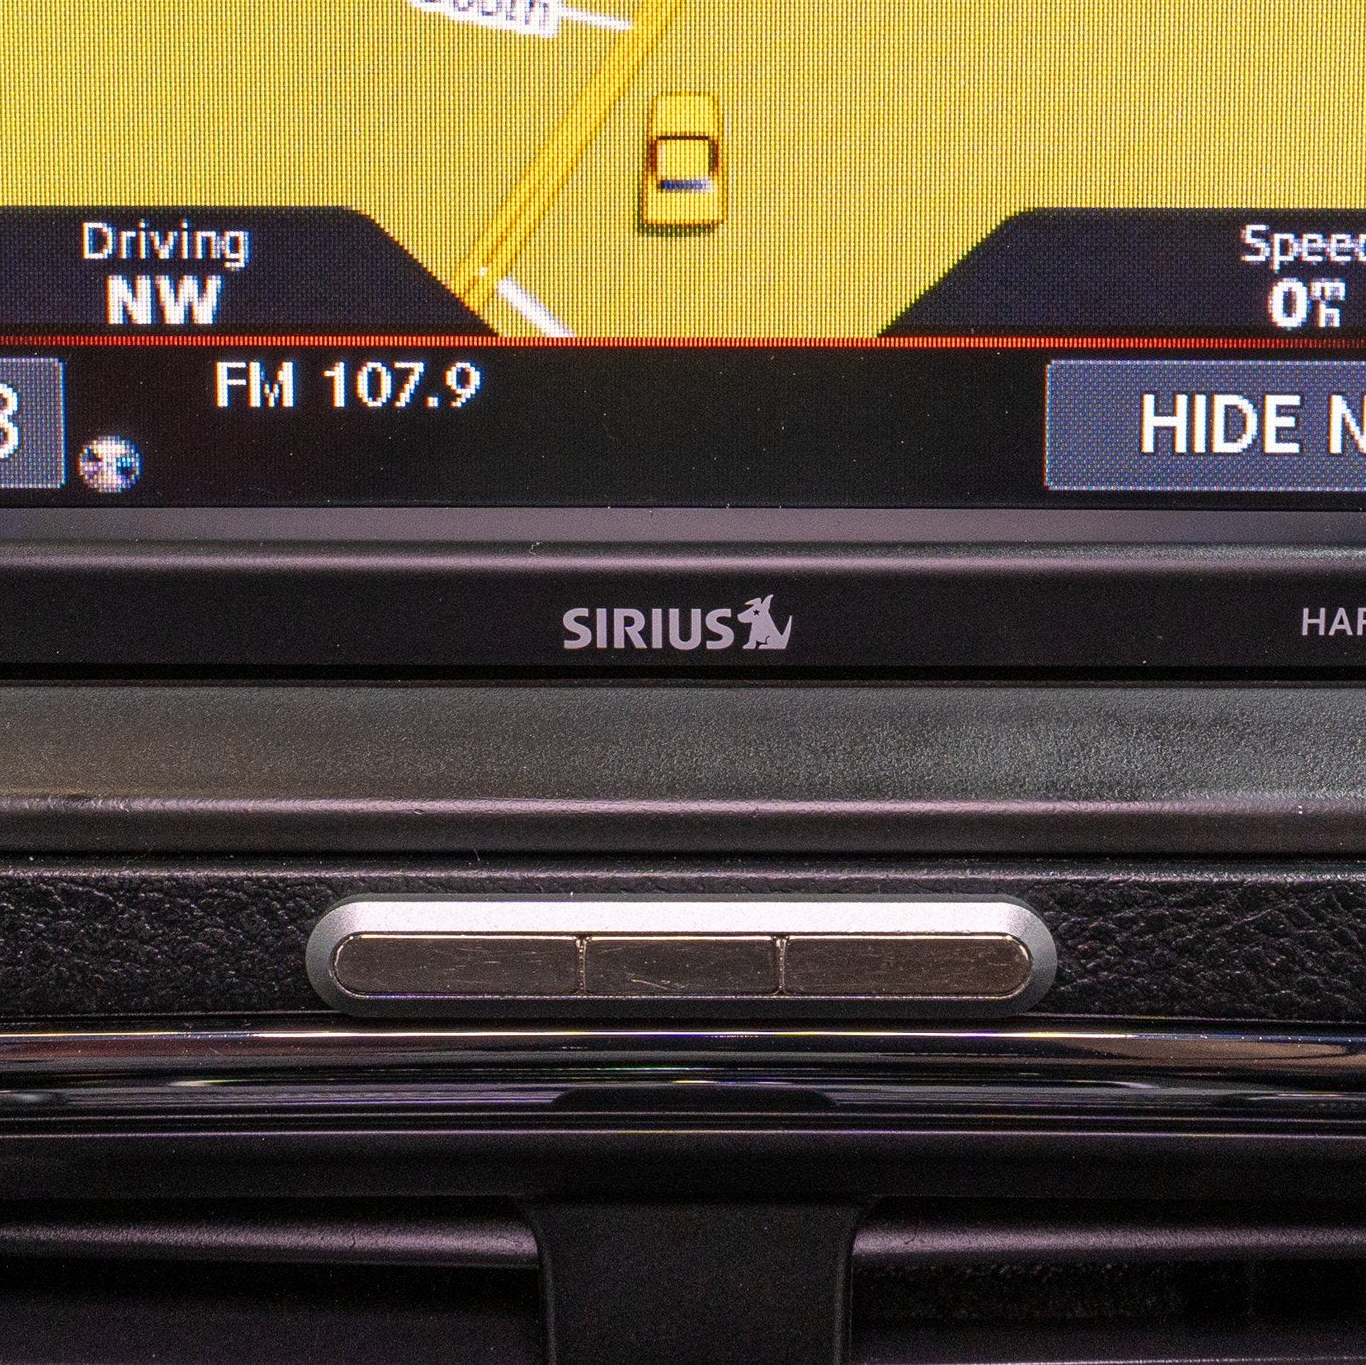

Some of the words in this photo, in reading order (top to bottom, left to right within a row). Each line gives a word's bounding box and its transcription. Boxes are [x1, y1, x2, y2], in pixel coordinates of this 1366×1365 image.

[82, 221, 250, 268] Driving
[107, 275, 222, 325] NW
[216, 360, 294, 409] FM
[323, 360, 483, 410] 107.9
[1140, 394, 1301, 455] HIDE
[562, 607, 736, 651] SIRIUS
